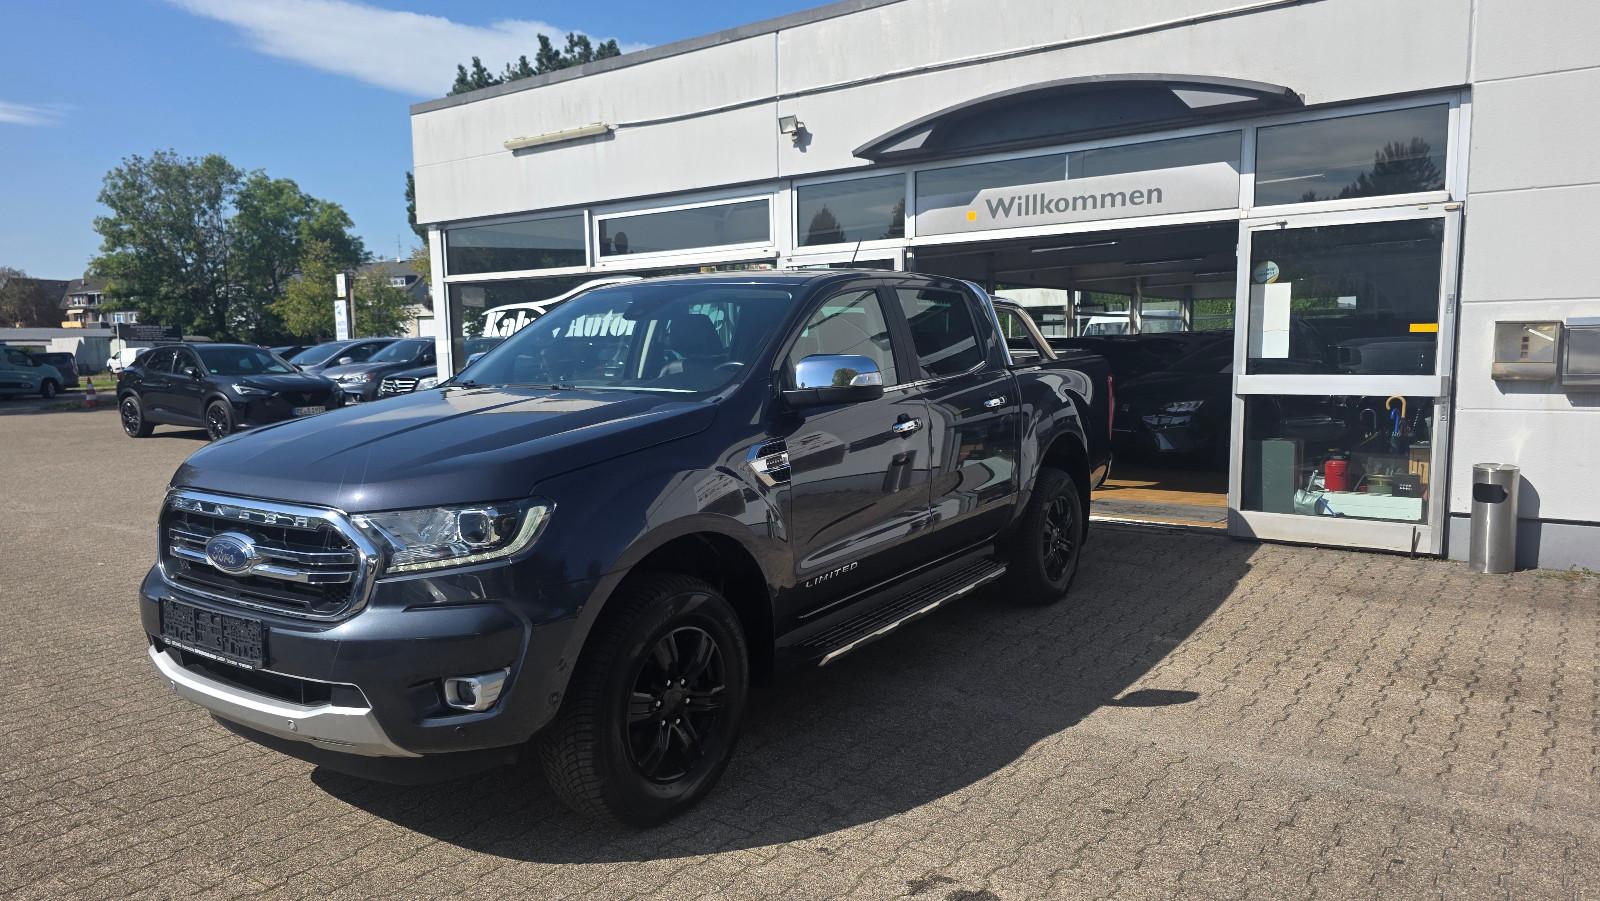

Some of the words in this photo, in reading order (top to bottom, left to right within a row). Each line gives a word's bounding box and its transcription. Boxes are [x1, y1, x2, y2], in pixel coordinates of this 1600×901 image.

[986, 187, 1163, 219] Willkommen
[172, 497, 308, 528] RANGER
[211, 543, 236, 565] Ford
[805, 561, 859, 588] LIMITED
